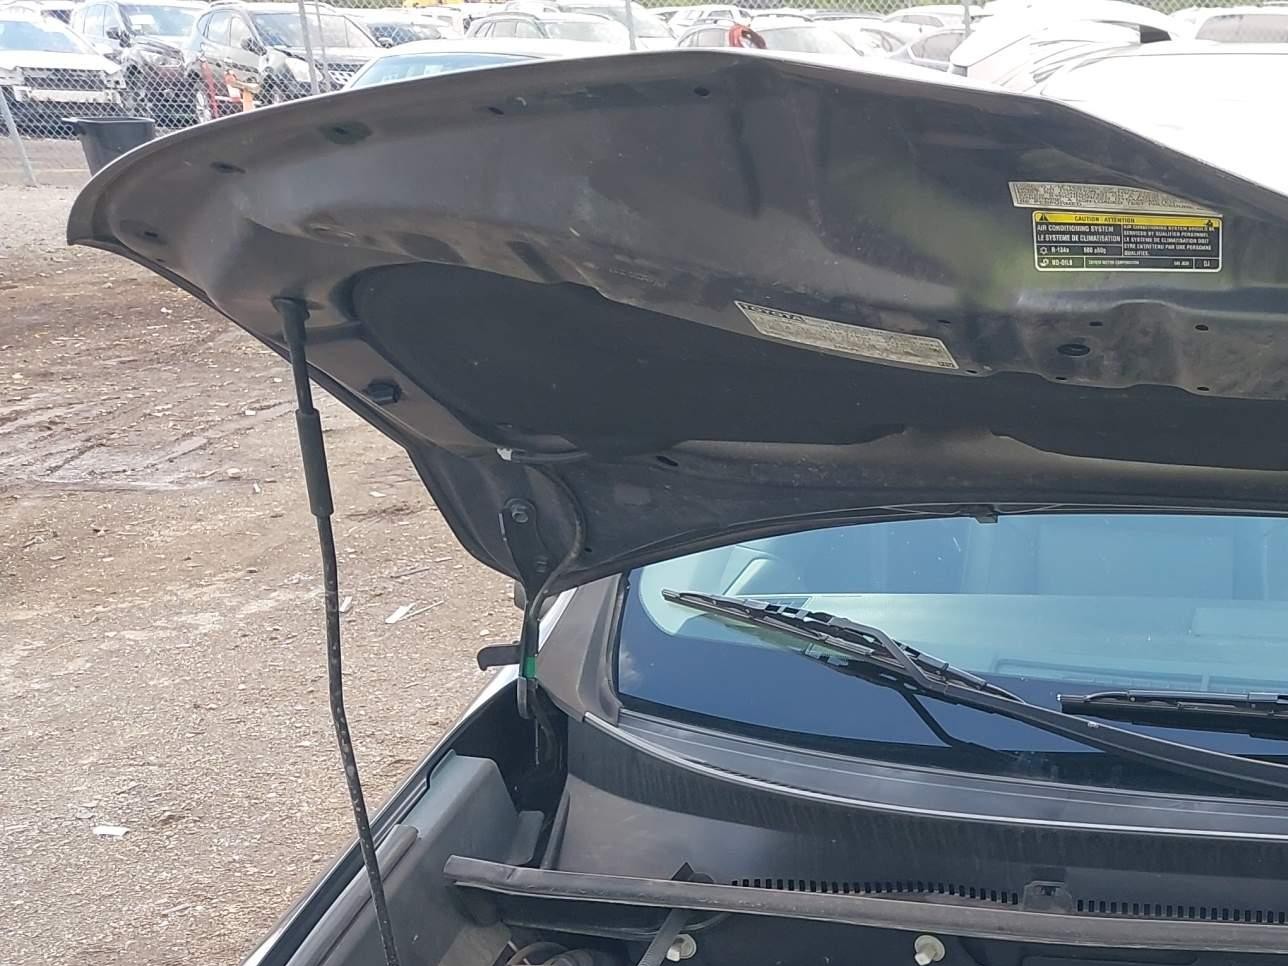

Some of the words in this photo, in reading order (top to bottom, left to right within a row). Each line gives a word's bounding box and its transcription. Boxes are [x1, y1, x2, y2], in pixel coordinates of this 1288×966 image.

[1104, 216, 1135, 224] ATTENTION
[1048, 224, 1090, 232] CONDITIONING
[1090, 225, 1114, 233] SYSTEM
[1071, 234, 1078, 242] DE
[1079, 235, 1121, 243] CLIMATISATION
[741, 303, 805, 321] TOYOTA
